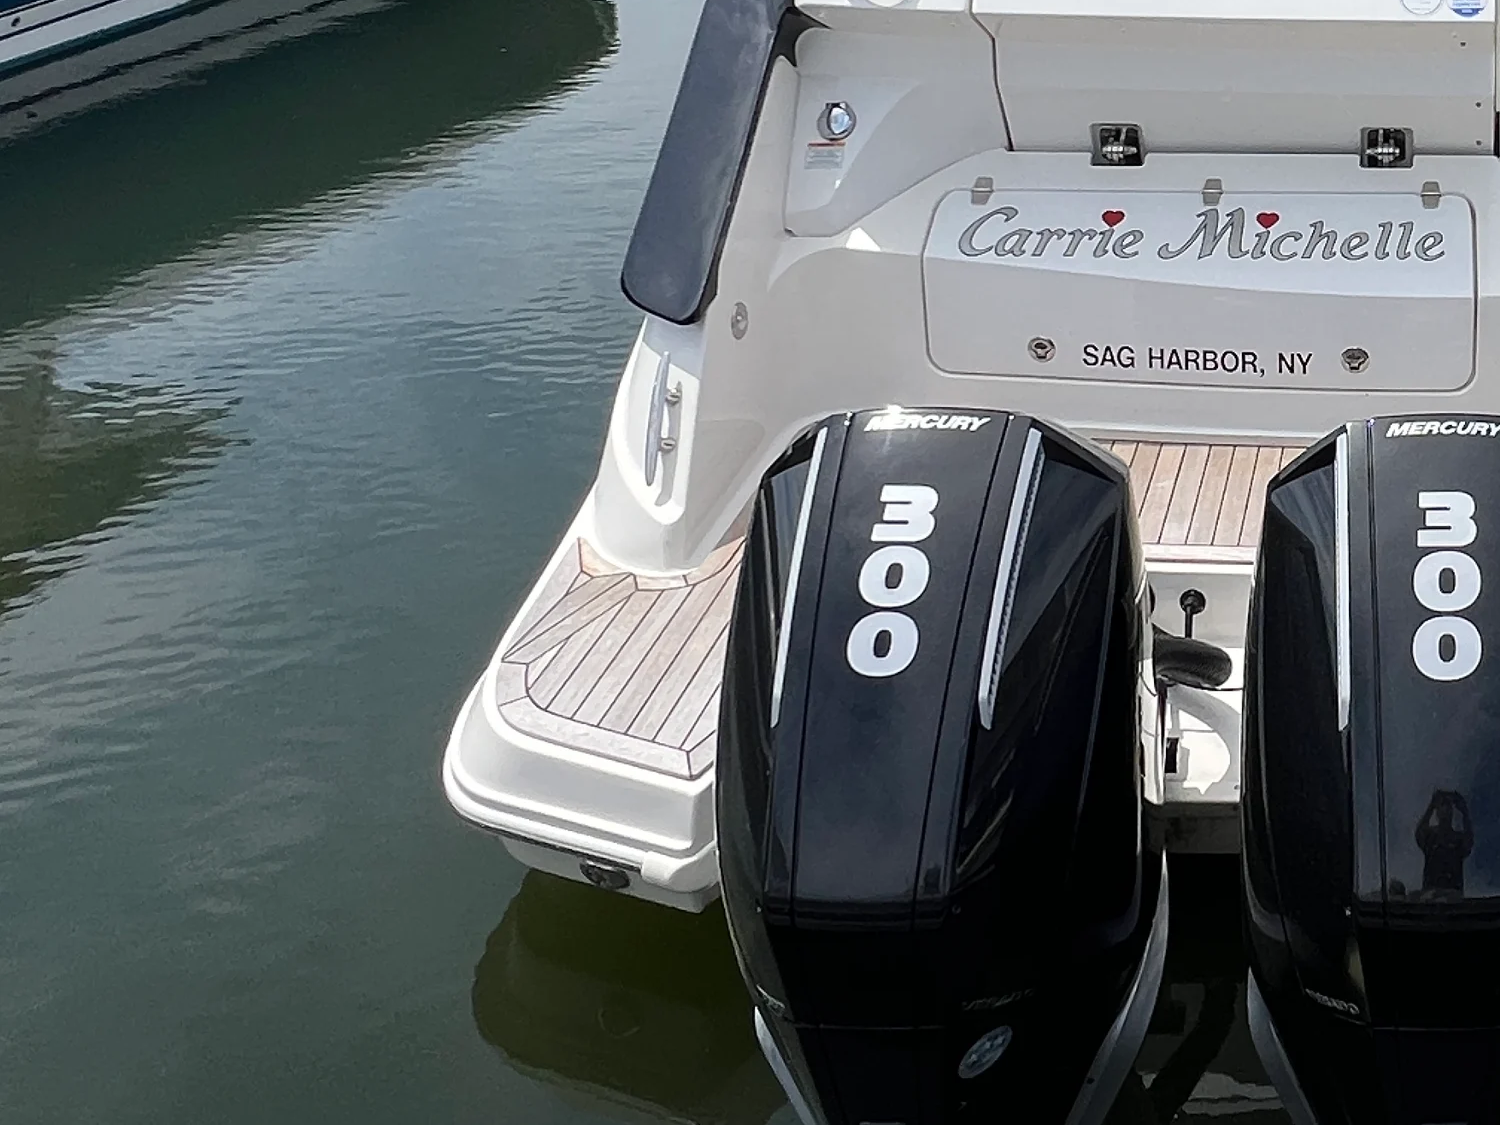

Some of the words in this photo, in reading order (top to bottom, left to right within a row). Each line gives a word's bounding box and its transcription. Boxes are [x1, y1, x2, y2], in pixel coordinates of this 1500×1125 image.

[958, 206, 1145, 259] Carrie
[1157, 207, 1446, 262] Michelle
[1082, 344, 1136, 369] SAG
[1148, 348, 1266, 377] HARBOR,
[1278, 352, 1313, 375] NY
[863, 414, 992, 432] MERCURY
[846, 484, 939, 677] 300
[1412, 491, 1482, 681] 300
